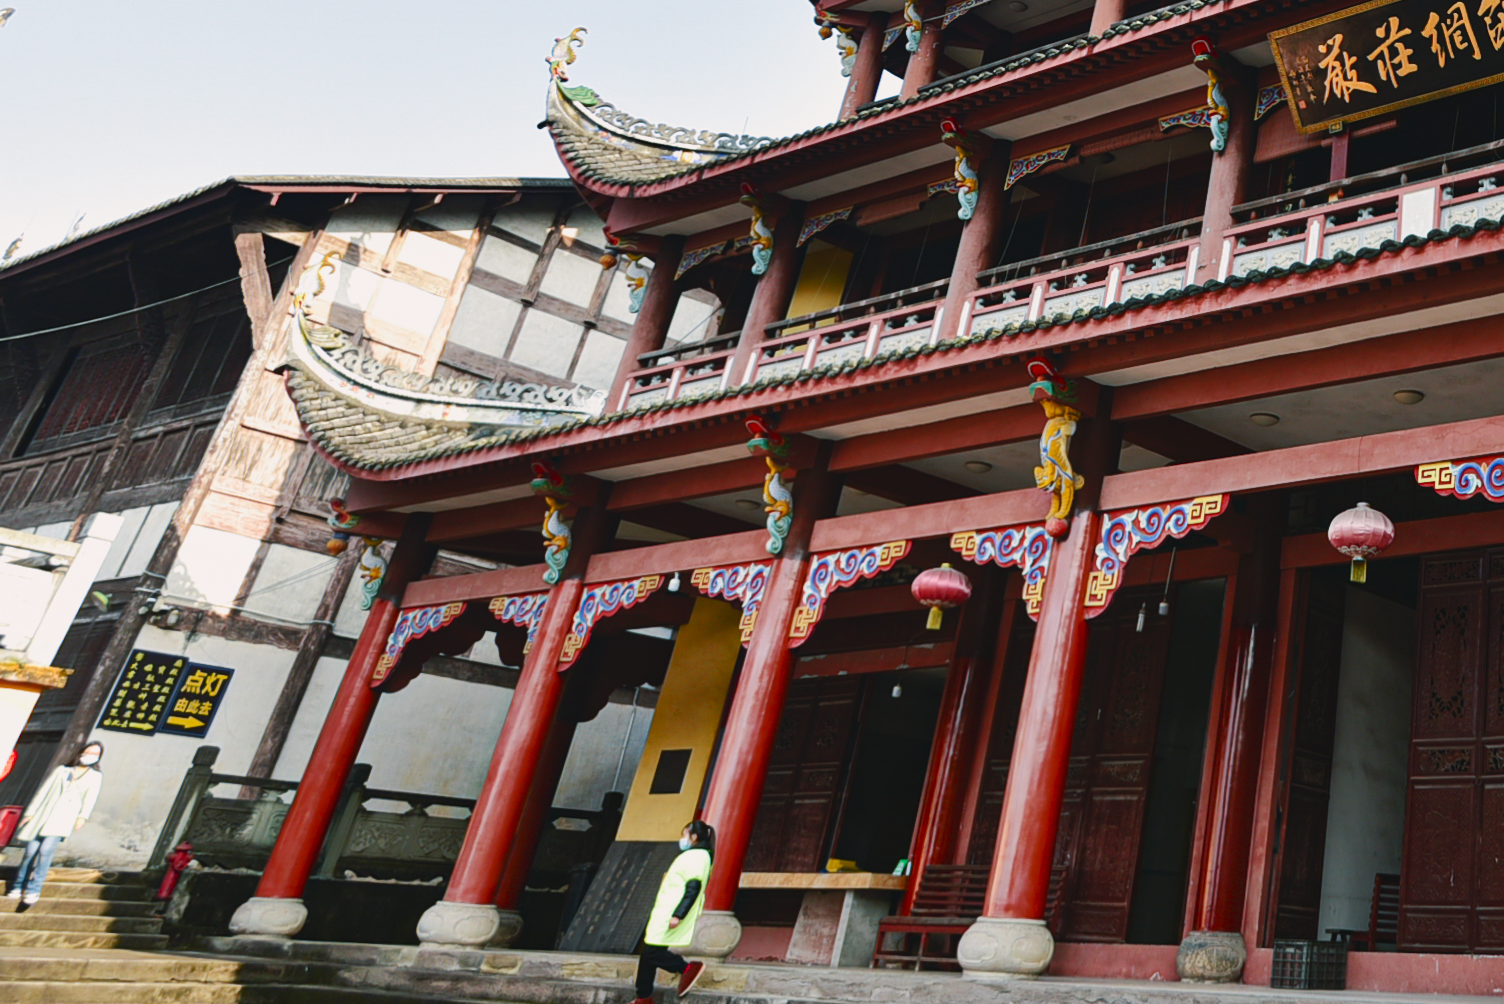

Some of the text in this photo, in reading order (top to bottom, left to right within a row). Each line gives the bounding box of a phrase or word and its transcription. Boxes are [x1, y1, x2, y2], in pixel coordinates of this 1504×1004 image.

[181, 669, 228, 697] 点灯
[173, 697, 213, 716] 由此去
